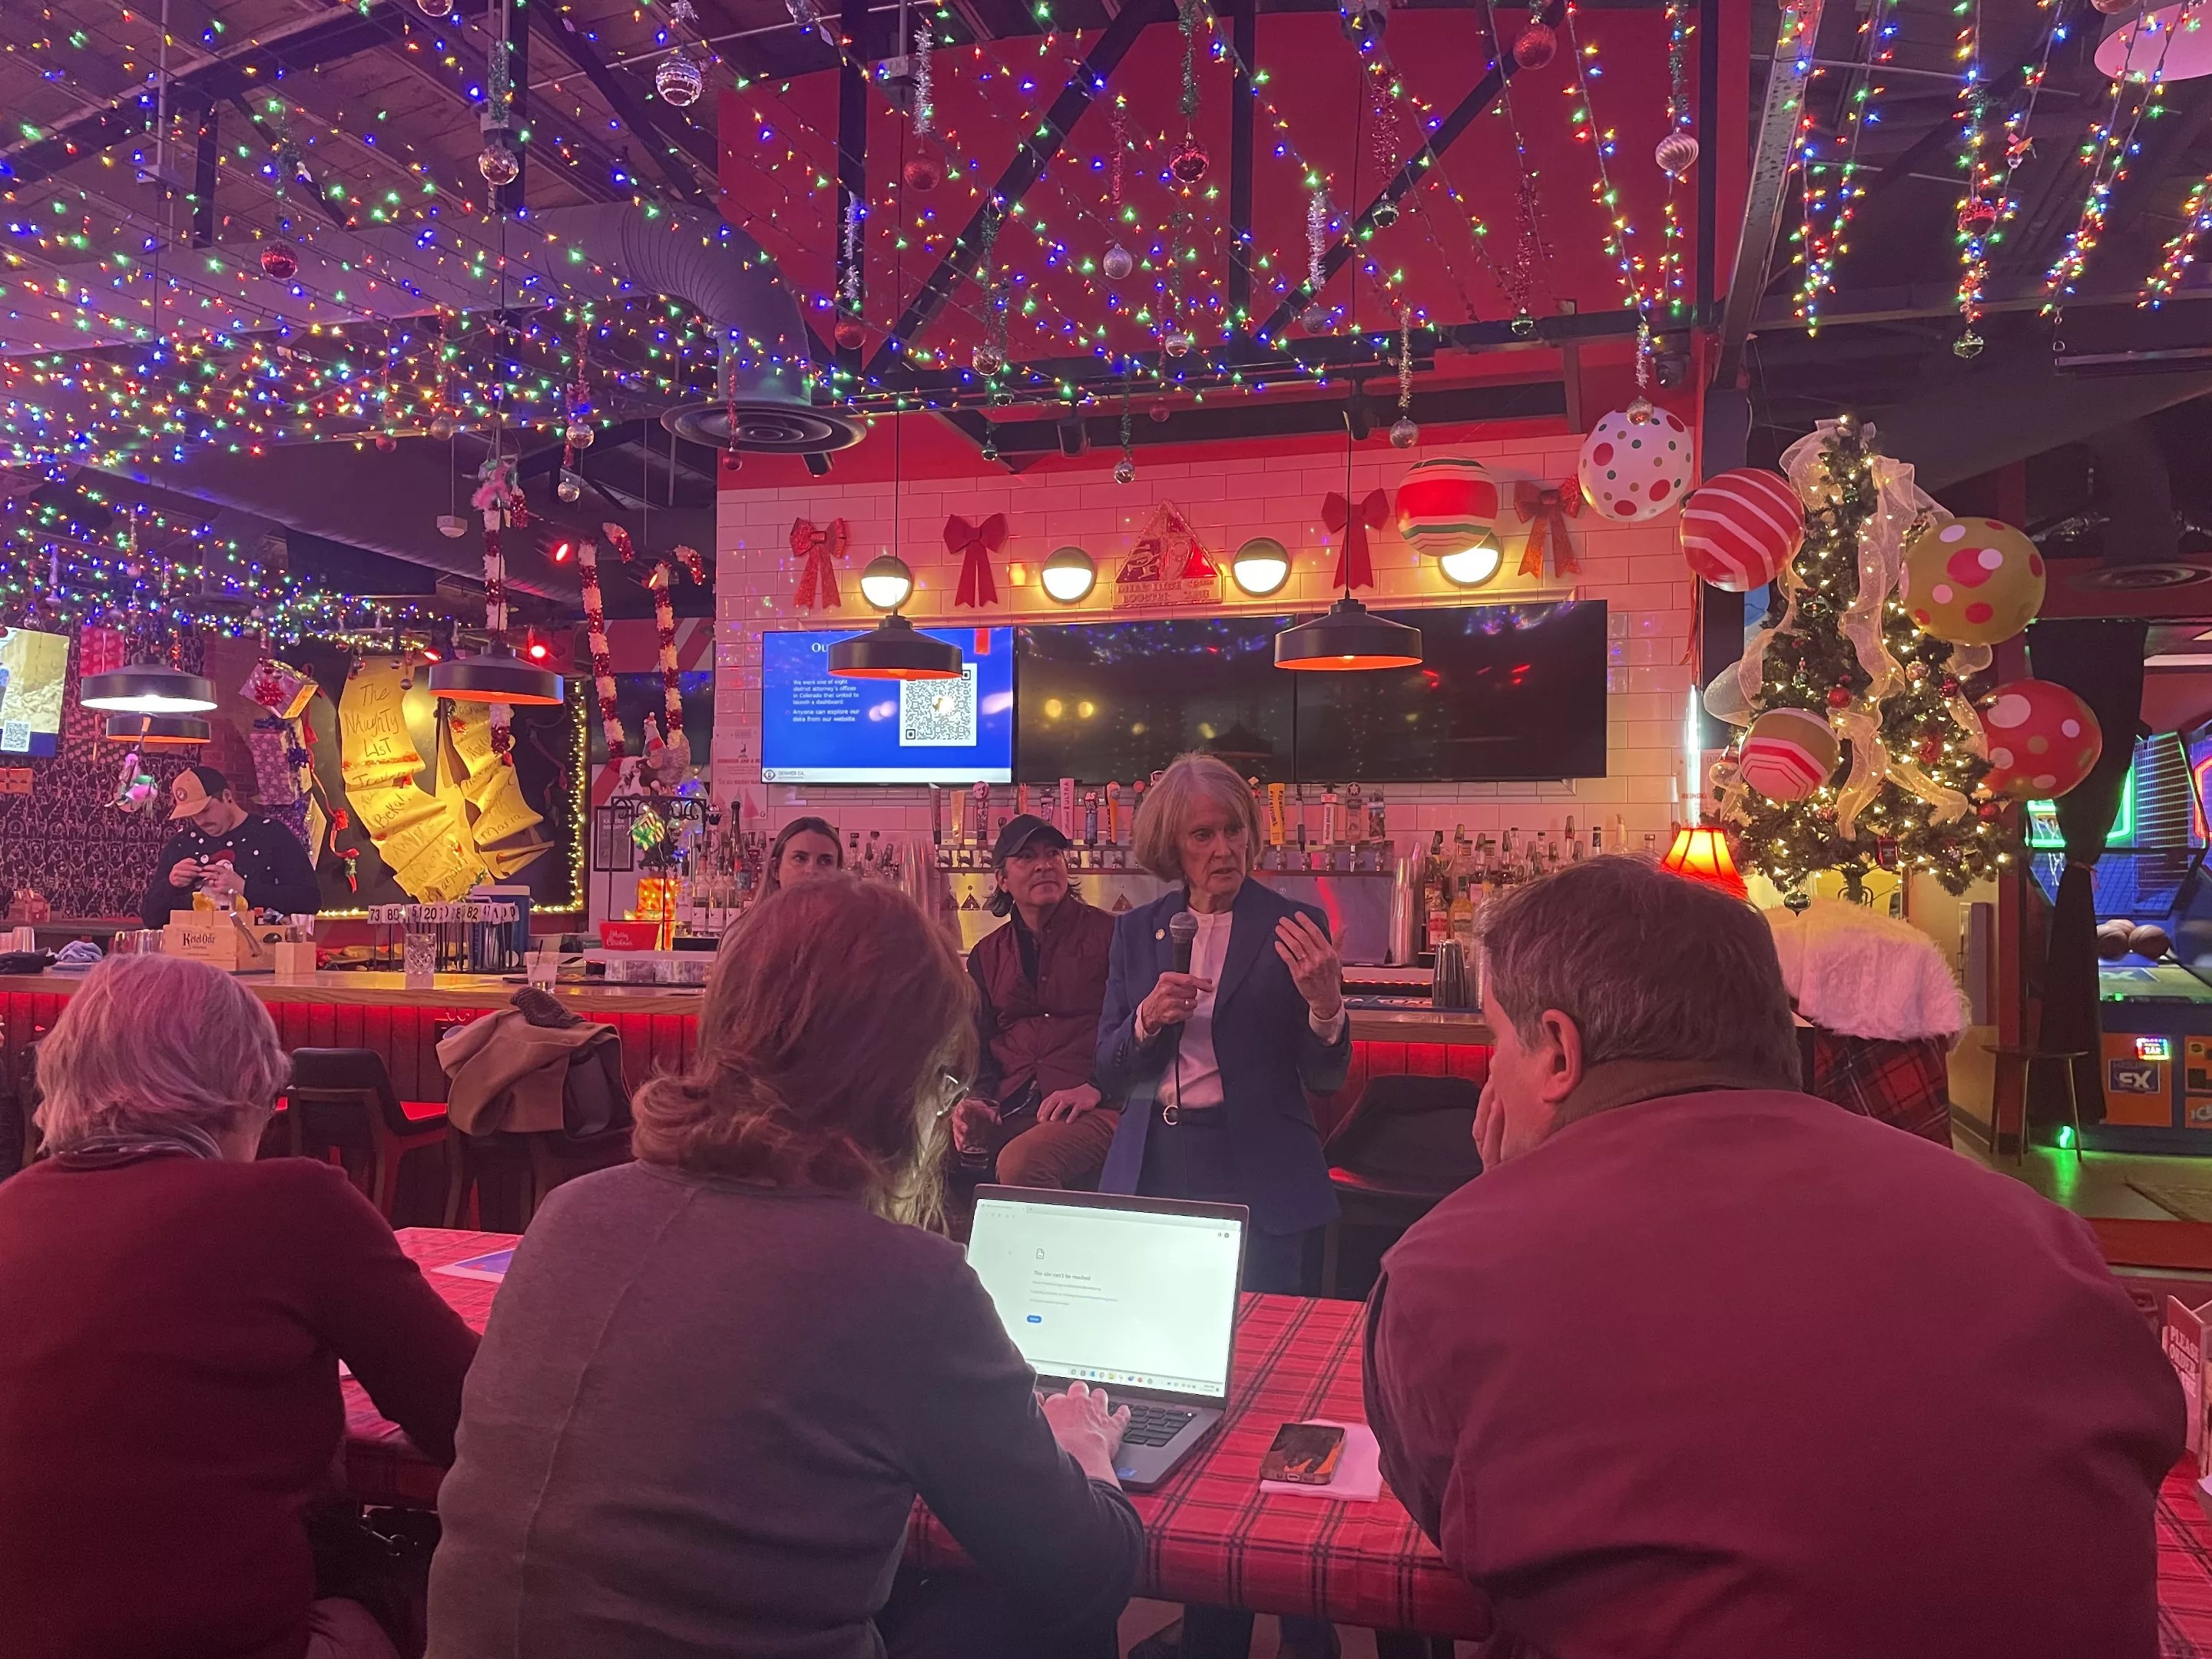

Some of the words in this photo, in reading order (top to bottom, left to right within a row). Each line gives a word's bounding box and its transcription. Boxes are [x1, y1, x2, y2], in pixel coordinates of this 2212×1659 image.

[811, 642, 828, 653] Ou
[359, 683, 391, 707] The
[370, 909, 380, 922] 73
[387, 908, 399, 921] 80
[424, 907, 437, 919] 20
[467, 906, 478, 920] 82
[183, 932, 202, 946] Ketel
[202, 933, 216, 944] One
